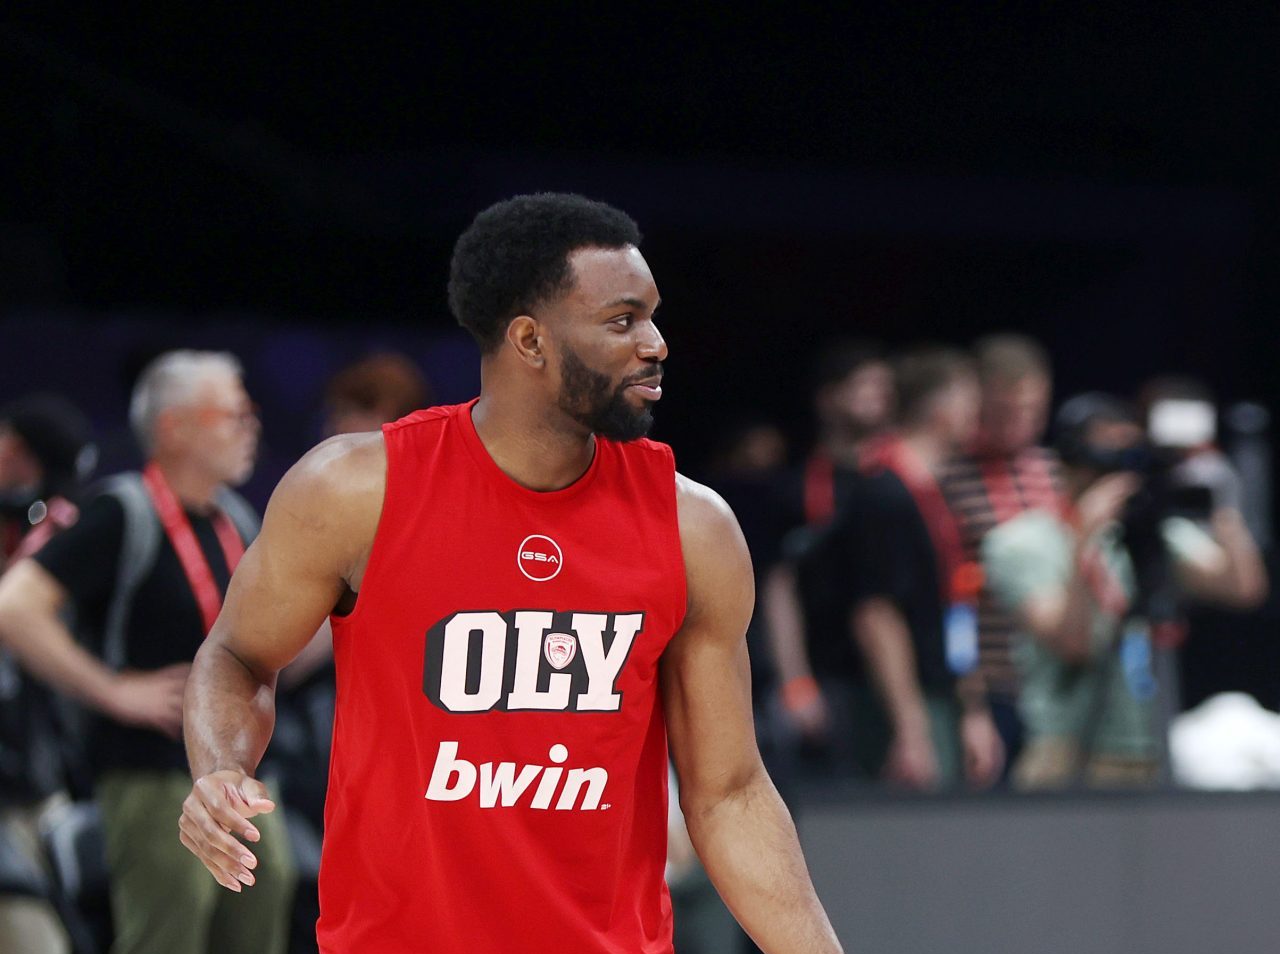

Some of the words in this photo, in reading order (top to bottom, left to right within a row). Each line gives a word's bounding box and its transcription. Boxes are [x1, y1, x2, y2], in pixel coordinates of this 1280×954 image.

[520, 550, 559, 564] GSA
[438, 611, 644, 712] OLY
[424, 741, 609, 811] bwin
